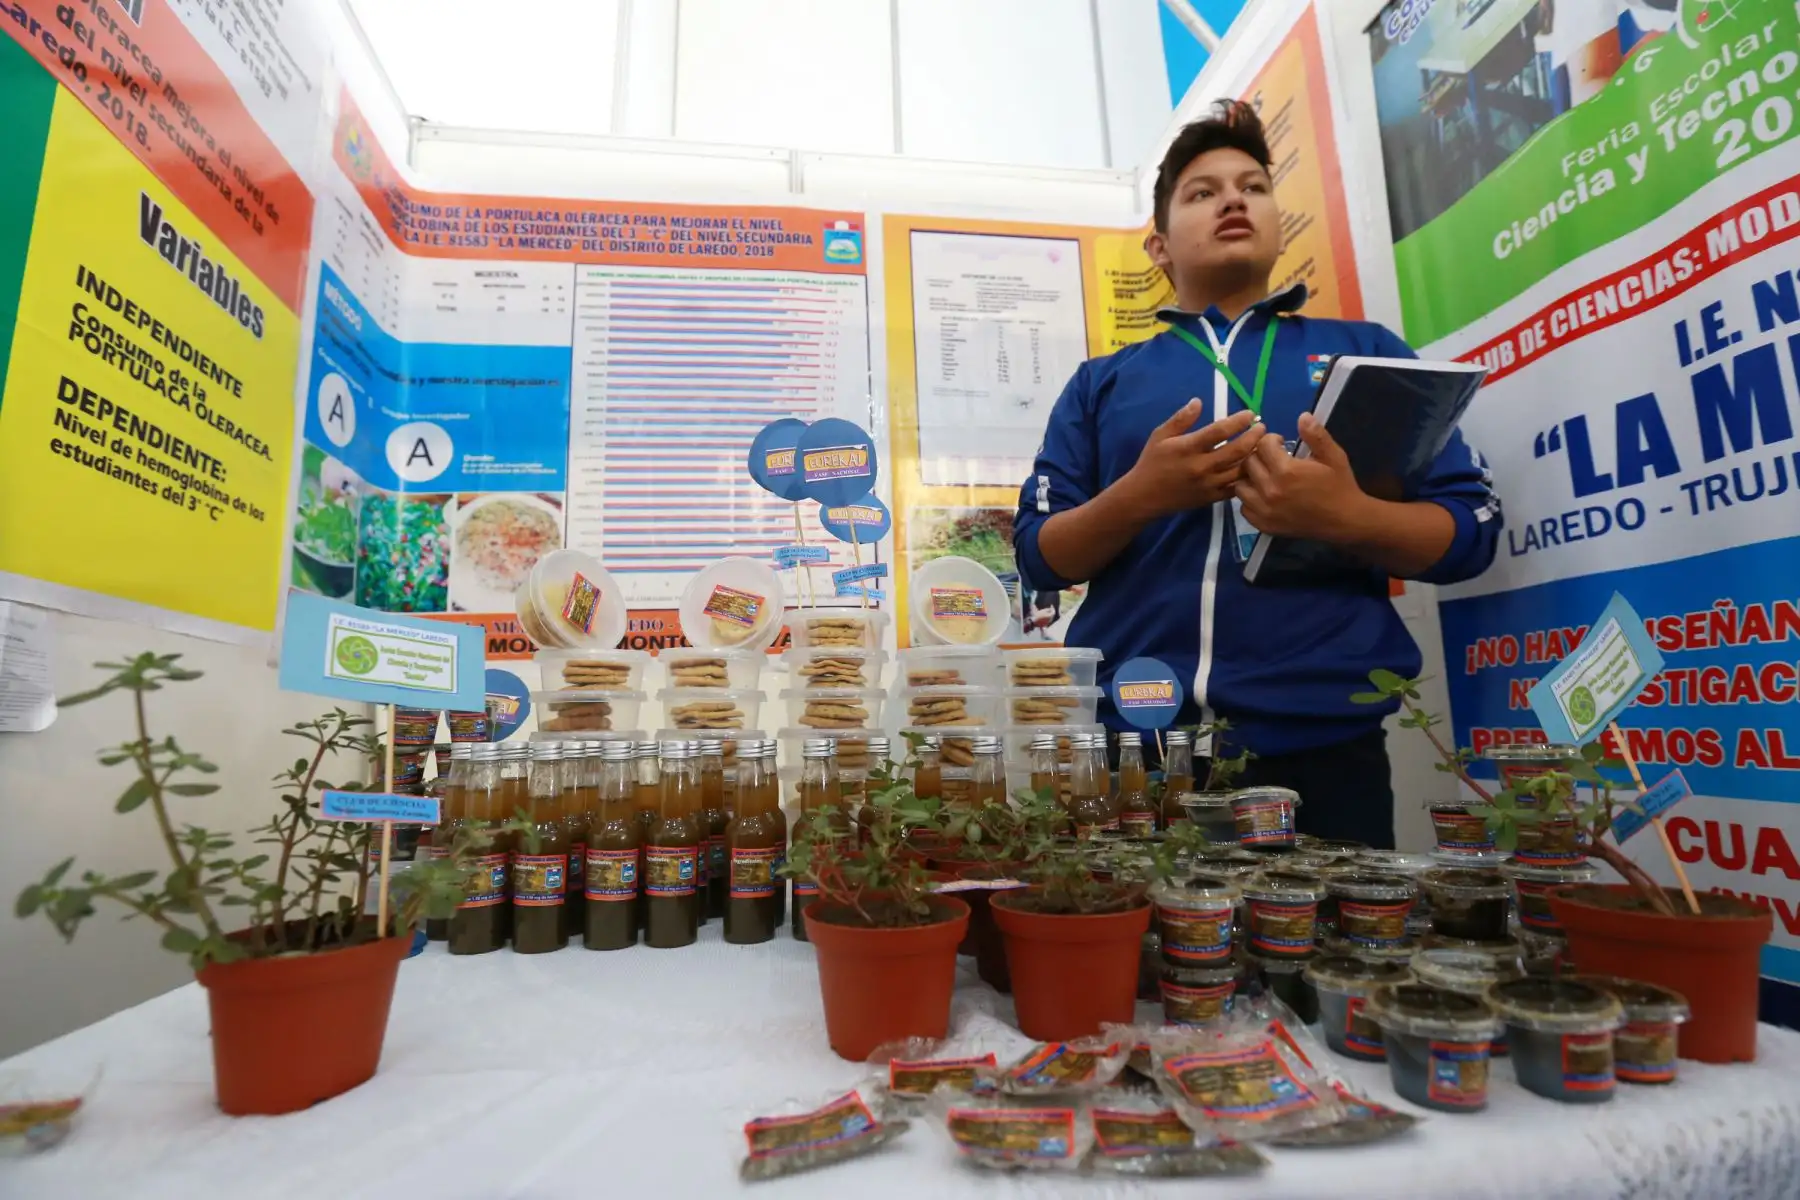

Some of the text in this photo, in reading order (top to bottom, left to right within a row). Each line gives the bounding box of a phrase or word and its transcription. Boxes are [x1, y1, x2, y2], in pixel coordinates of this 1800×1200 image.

[55, 3, 265, 237] del nivel secundaria de la
[97, 81, 152, 154] 2018.
[1561, 19, 1779, 178] Feria Escolar
[1707, 95, 1800, 170] 20
[162, 82, 216, 152] mejora
[218, 146, 231, 169] el
[233, 162, 264, 208] nivel
[264, 201, 280, 226] de
[1492, 51, 1800, 260] Ciencia y Tecno
[140, 190, 265, 336] Variables
[445, 206, 461, 218] DE
[466, 207, 481, 219] LA
[486, 208, 560, 223] PORTULACA
[564, 212, 630, 225] OLERACEA
[633, 215, 667, 227] PARA
[670, 217, 728, 229] MEJORAR
[732, 219, 746, 230] EL
[750, 219, 784, 231] NIVEL
[464, 220, 481, 233] DE
[485, 221, 509, 234] LOS
[513, 223, 597, 238] ESTUDIANTES
[601, 227, 624, 239] DEL
[671, 231, 693, 242] DEL
[697, 231, 738, 243] NIVEL
[737, 232, 813, 245] SECUNDARIA
[494, 236, 514, 249] "LA
[518, 237, 578, 251] MERCED"
[582, 240, 605, 251] DEL
[609, 241, 665, 255] DISTRITO
[669, 243, 685, 255] DE
[745, 245, 775, 258] 2018
[75, 264, 243, 400] INDEPENDIENTE
[1519, 319, 1548, 358] DE
[1550, 245, 1704, 340] CIENCIAS:
[1674, 300, 1743, 368] I.E.
[68, 320, 191, 413] PORTULACA
[72, 302, 207, 402] Consumo de la
[56, 374, 227, 483] DEPENDIENTE:
[328, 393, 345, 433] A
[406, 437, 434, 467] A
[1533, 392, 1681, 498] "LA
[50, 436, 158, 496] estudiantes
[161, 487, 185, 508] del
[53, 407, 265, 522] Nivel de hemoglobina de los
[1508, 497, 1646, 557] LAREDO
[1465, 634, 1520, 676] ¡NO
